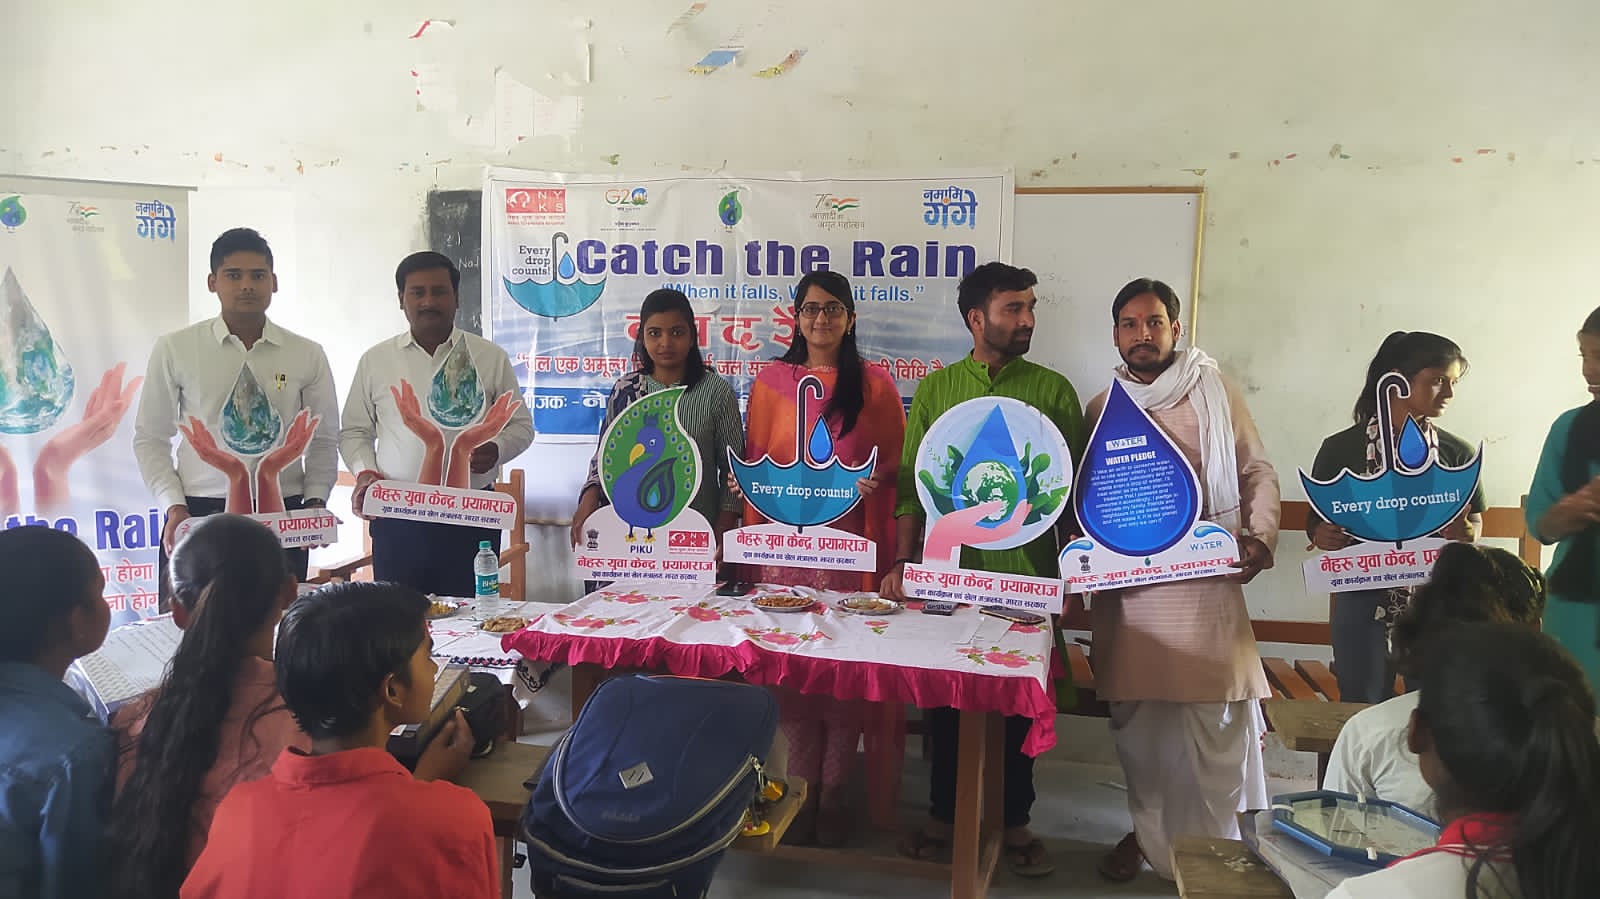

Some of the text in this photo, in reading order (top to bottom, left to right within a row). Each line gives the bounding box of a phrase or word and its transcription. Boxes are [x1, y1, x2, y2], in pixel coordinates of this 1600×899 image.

[924, 185, 962, 202] नमामि
[924, 190, 978, 230] गंगे
[519, 245, 551, 256] Every
[576, 240, 976, 277] Catch the Rain
[525, 255, 551, 266] drop
[512, 266, 551, 276] counts!
[726, 284, 736, 299] it
[742, 284, 782, 302] falls,
[854, 286, 866, 300] it
[554, 356, 579, 374] एक
[717, 360, 742, 374] जल
[895, 358, 928, 380] विधि
[1106, 450, 1156, 466] WATER PLEDGE
[372, 484, 402, 502] नेहरू
[404, 490, 425, 507] युवा
[462, 497, 515, 514] प्रयागराज
[752, 482, 854, 499] Every drop counts!
[1332, 489, 1460, 514] Every drop counts!
[95, 508, 168, 550] Rai
[278, 515, 334, 534] प्रयागराज
[630, 545, 653, 554] PIKU
[736, 529, 763, 546] नेहरू
[766, 533, 784, 550] युवा
[818, 538, 868, 553] प्रयागराज
[116, 560, 153, 582] होगा
[578, 556, 606, 568] नेहरू
[608, 558, 628, 571] युवा
[662, 561, 713, 572] प्रयागराज
[1066, 574, 1102, 585] नेहरू
[1104, 570, 1127, 582] युवा
[1170, 557, 1234, 572] प्रयागराज
[1320, 555, 1354, 573] नेहरू
[1357, 553, 1381, 573] युवा
[904, 566, 935, 584] नेहरू
[938, 572, 960, 589] युवा
[1000, 579, 1058, 597] प्रयागराज
